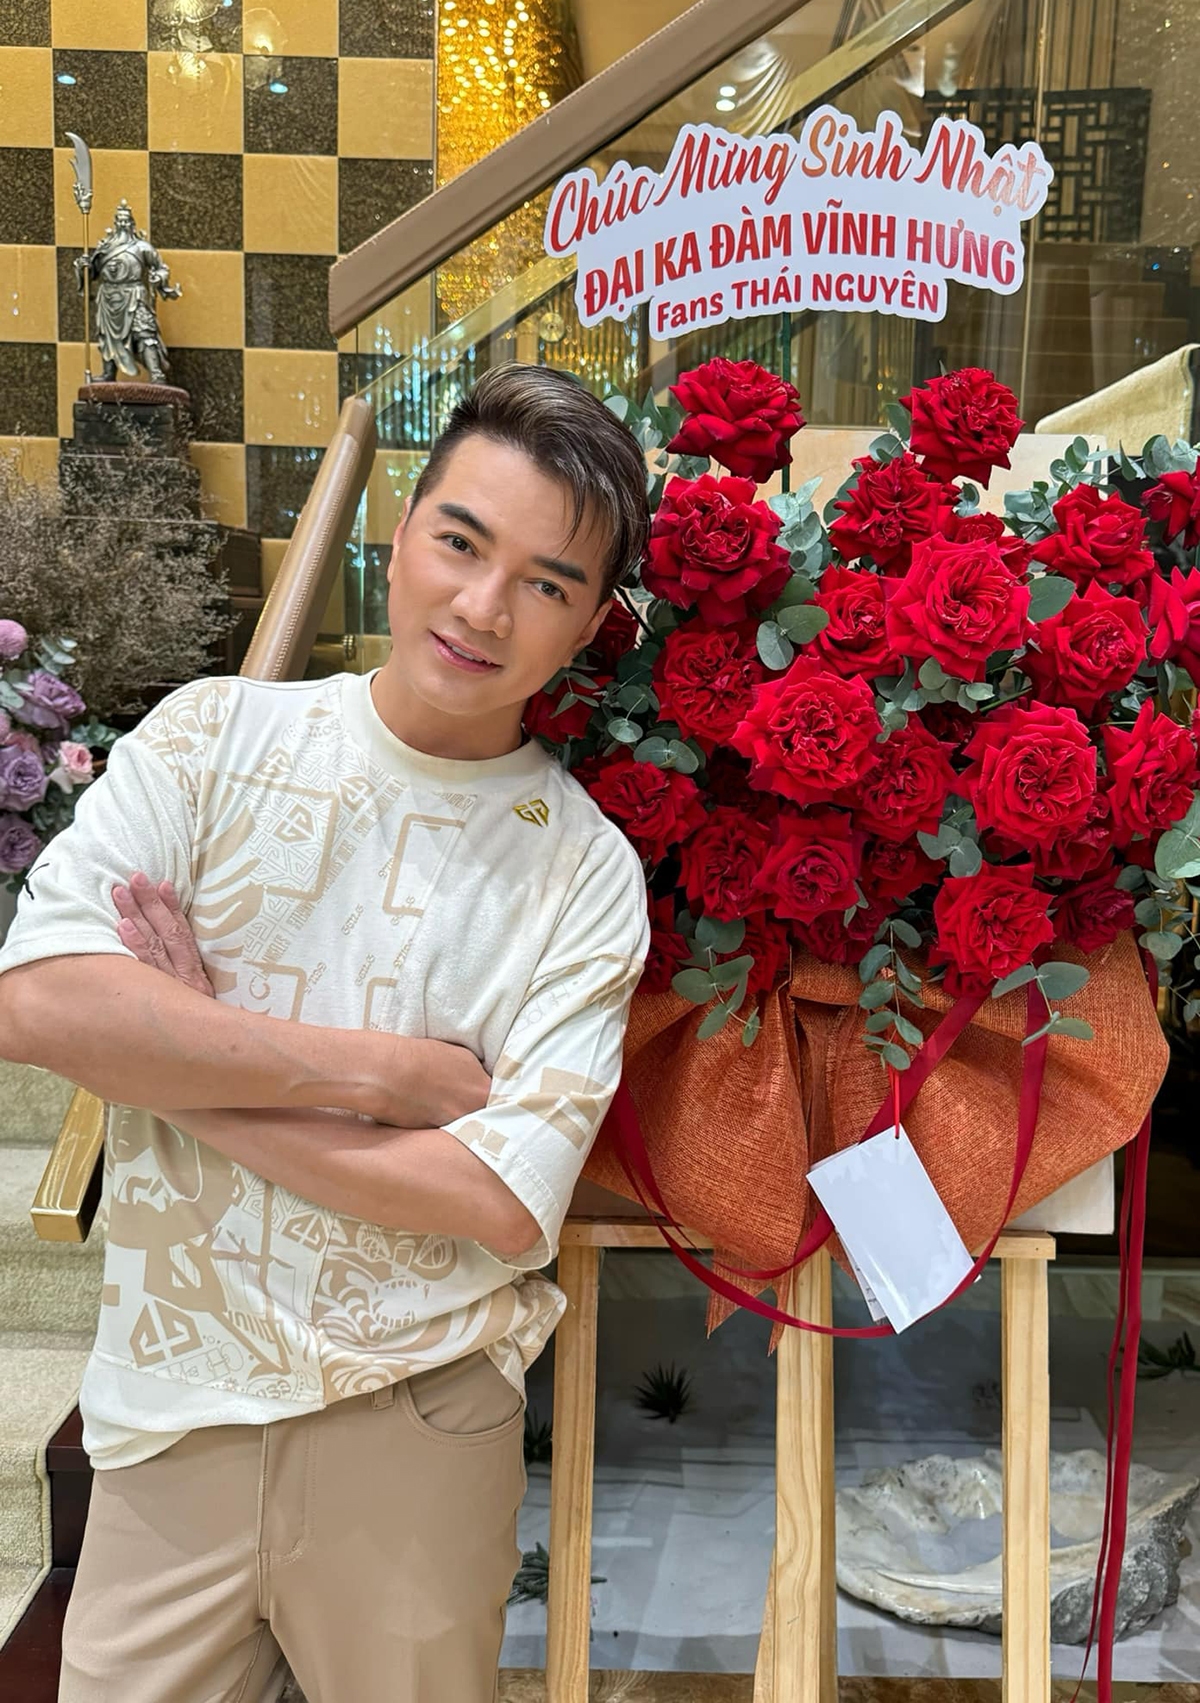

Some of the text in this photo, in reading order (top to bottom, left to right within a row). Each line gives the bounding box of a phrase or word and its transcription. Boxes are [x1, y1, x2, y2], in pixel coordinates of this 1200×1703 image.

[550, 114, 1047, 252] Chúc Mừng Sinh Nhật
[584, 198, 1016, 318] ĐẠI KA ĐÀM VĨNH HƯNG
[656, 266, 939, 333] Fans THÁI NGUYÊN
